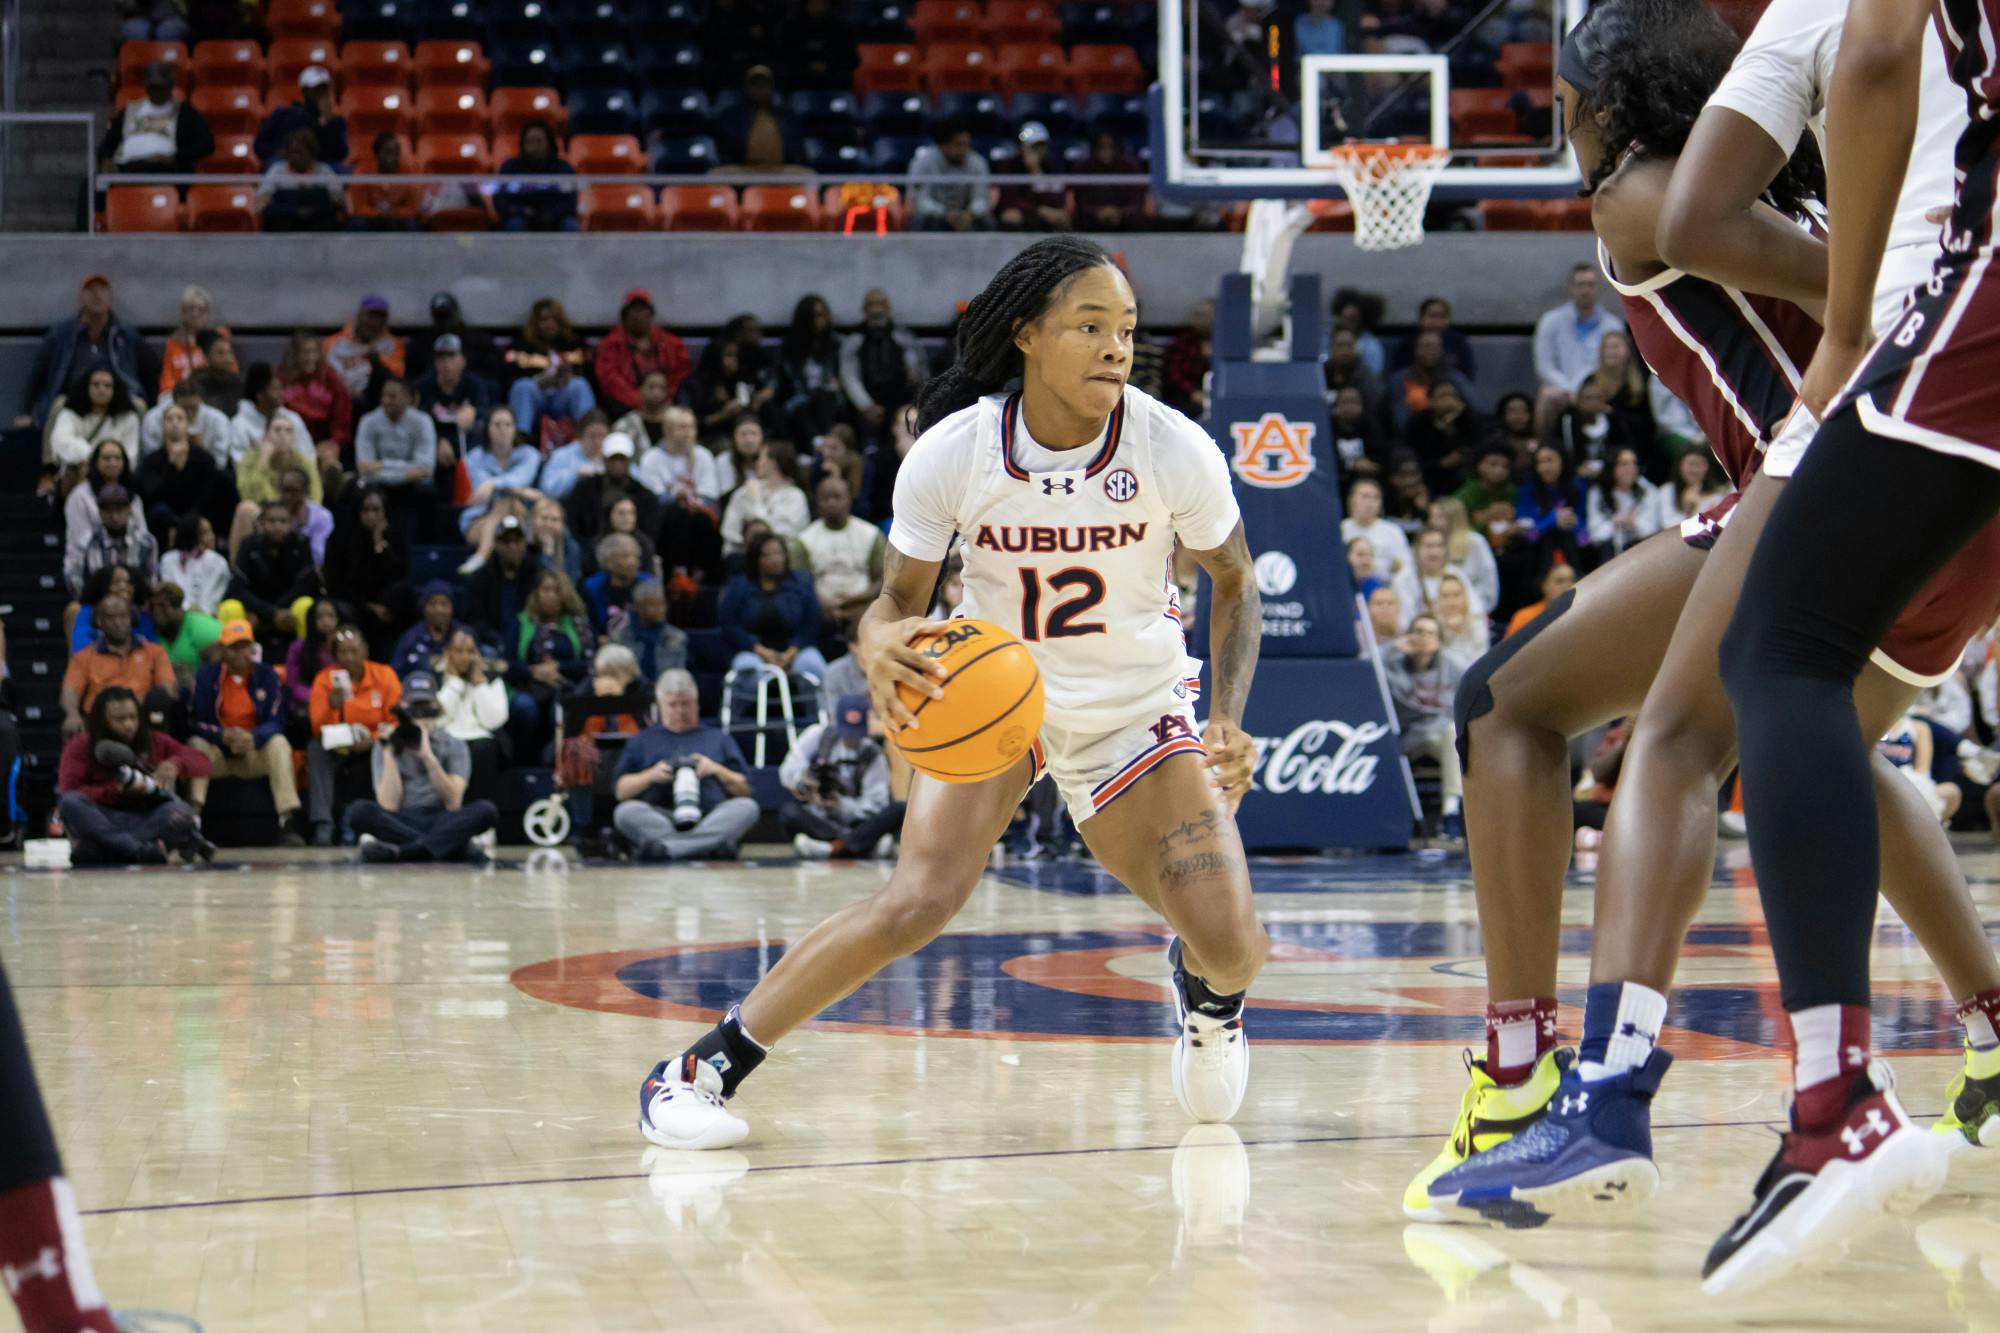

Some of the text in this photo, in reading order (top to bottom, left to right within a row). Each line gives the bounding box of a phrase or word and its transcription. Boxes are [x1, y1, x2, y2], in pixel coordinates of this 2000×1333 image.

[1105, 470, 1137, 501] SEC
[975, 521, 1149, 552] AUBURN
[1018, 566, 1107, 643] 12
[1261, 601, 1305, 619] IND
[922, 624, 984, 659] CAA
[1260, 619, 1308, 637] REEK
[1199, 719, 1390, 795] -Cola
